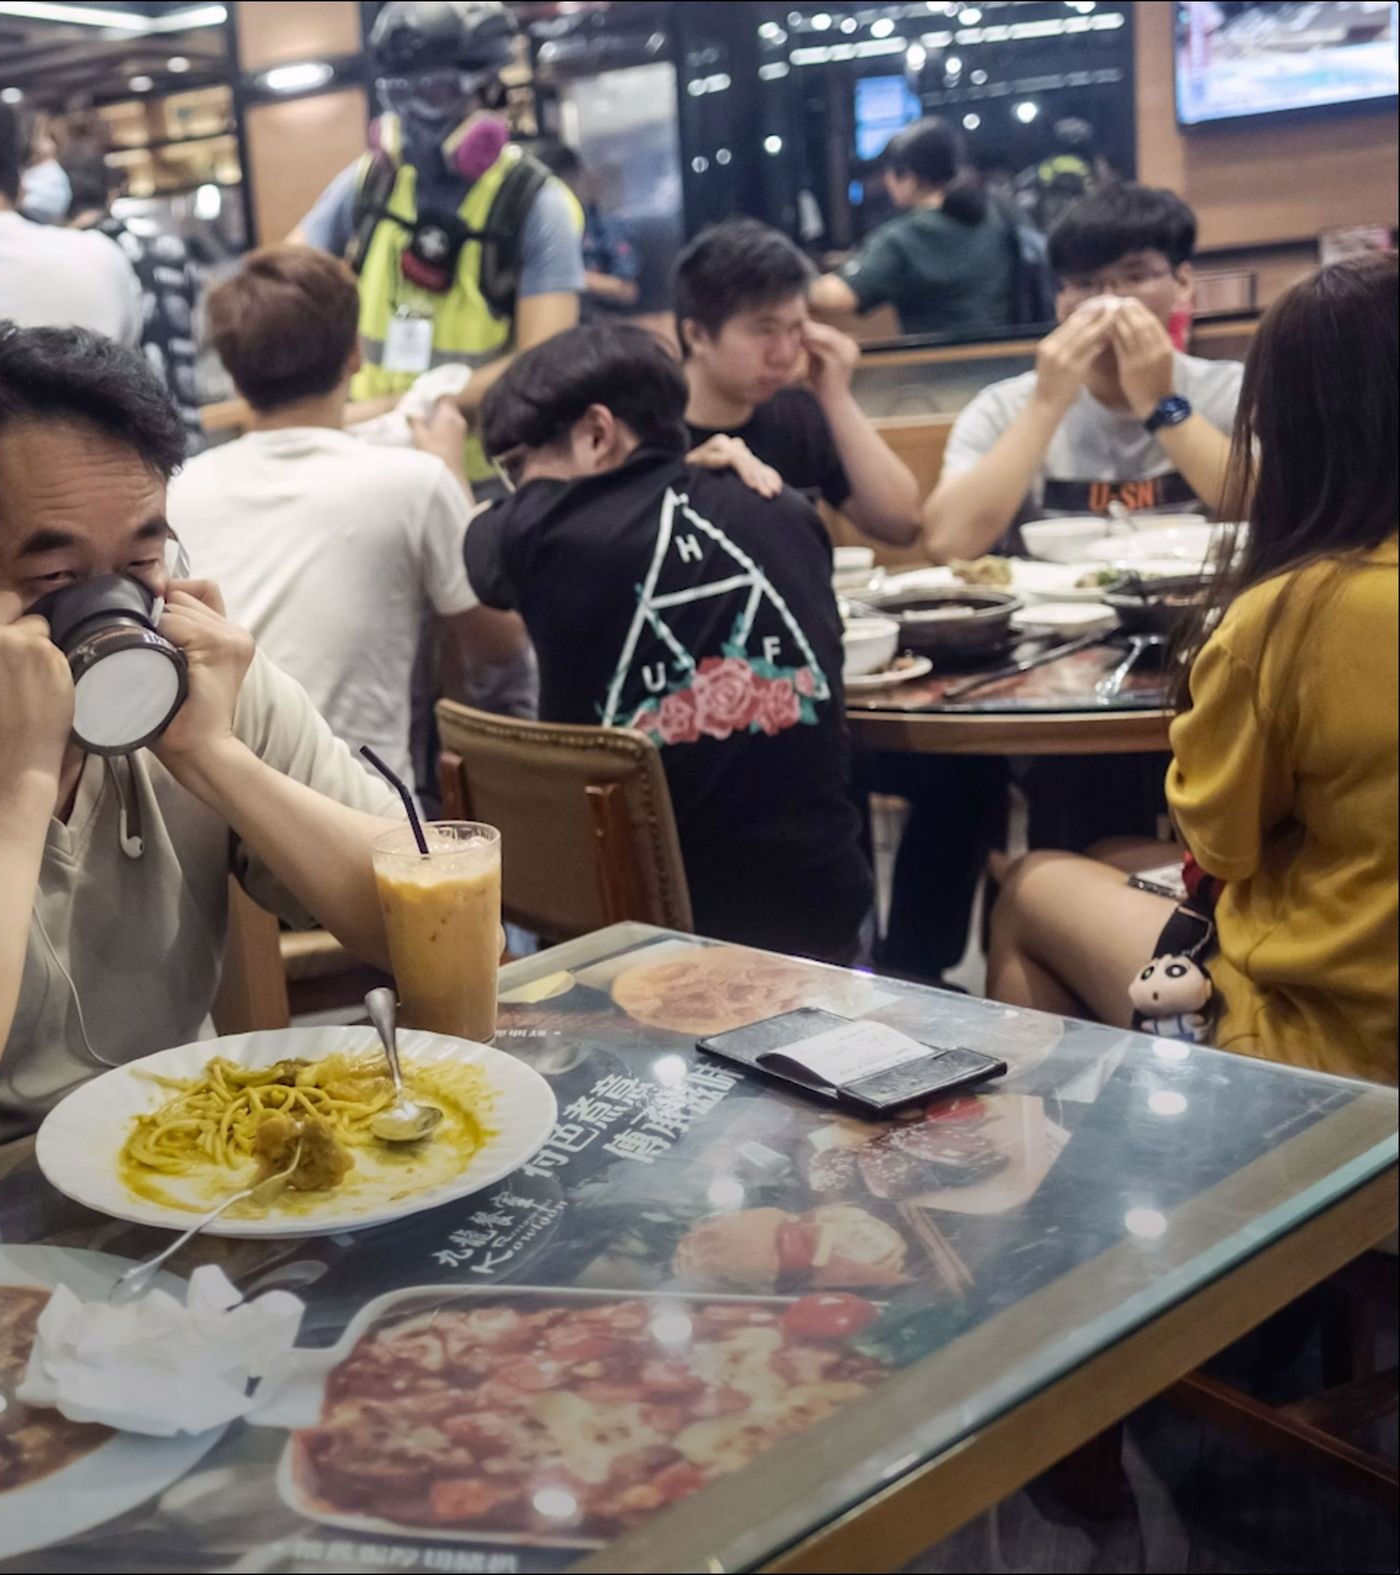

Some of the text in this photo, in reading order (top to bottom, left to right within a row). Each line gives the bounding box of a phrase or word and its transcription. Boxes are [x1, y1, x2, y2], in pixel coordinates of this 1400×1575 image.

[675, 533, 703, 563] H
[642, 636, 781, 692] U F
[470, 1201, 568, 1273] Kowloon
